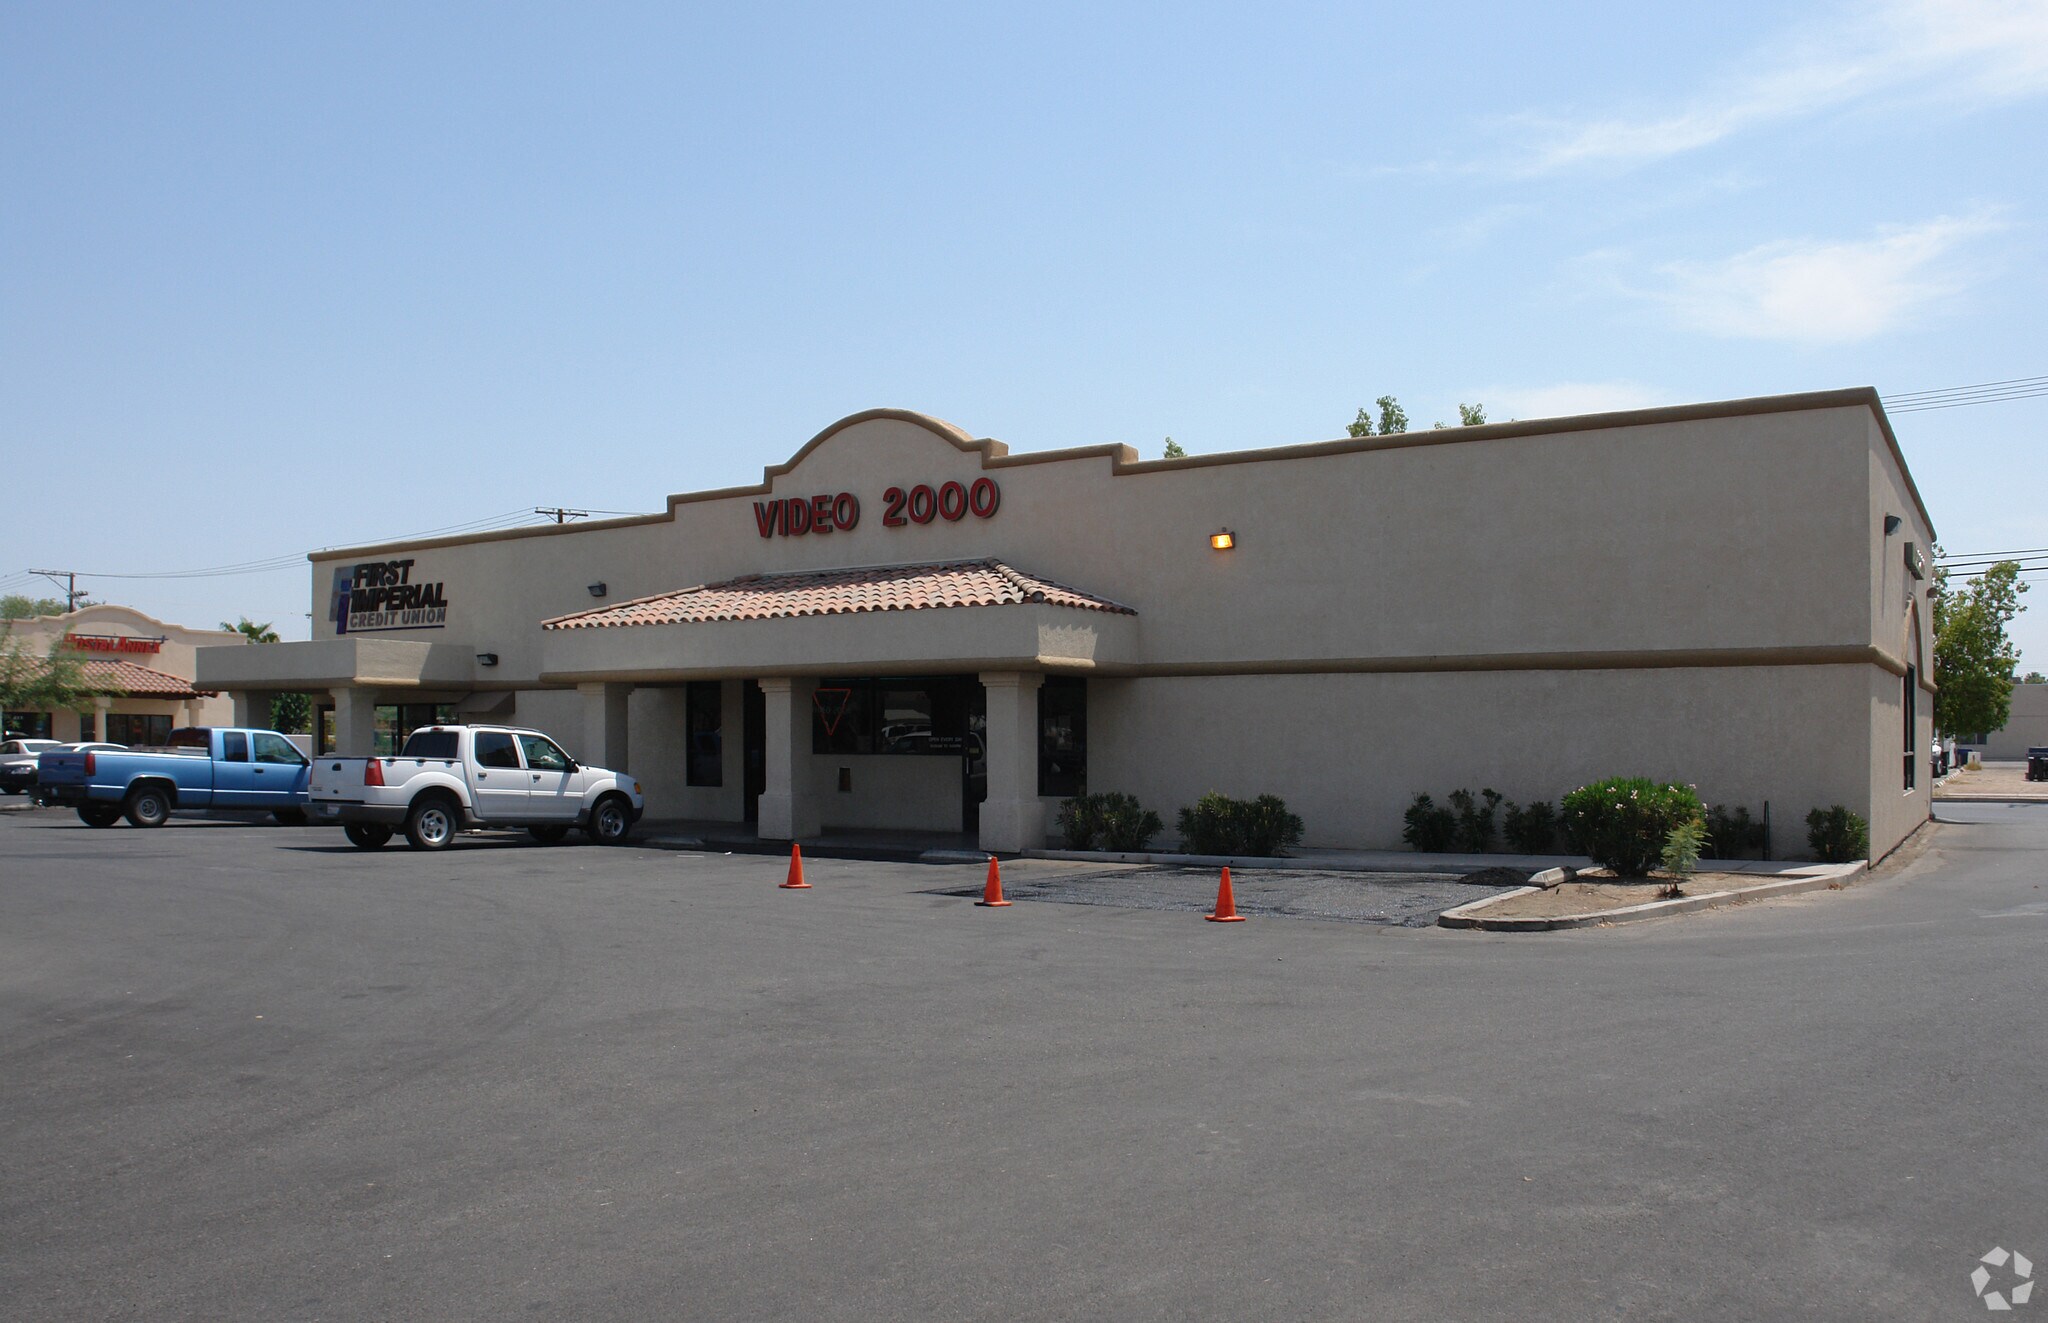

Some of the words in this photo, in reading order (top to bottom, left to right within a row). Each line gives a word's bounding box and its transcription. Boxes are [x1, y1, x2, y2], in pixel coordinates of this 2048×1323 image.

[753, 492, 860, 538] VIDEO
[882, 477, 1001, 526] 2000
[353, 559, 415, 588] FIRST
[350, 582, 448, 613] IMPERIAL
[349, 611, 398, 628] CREDIT
[401, 608, 447, 625] UNION
